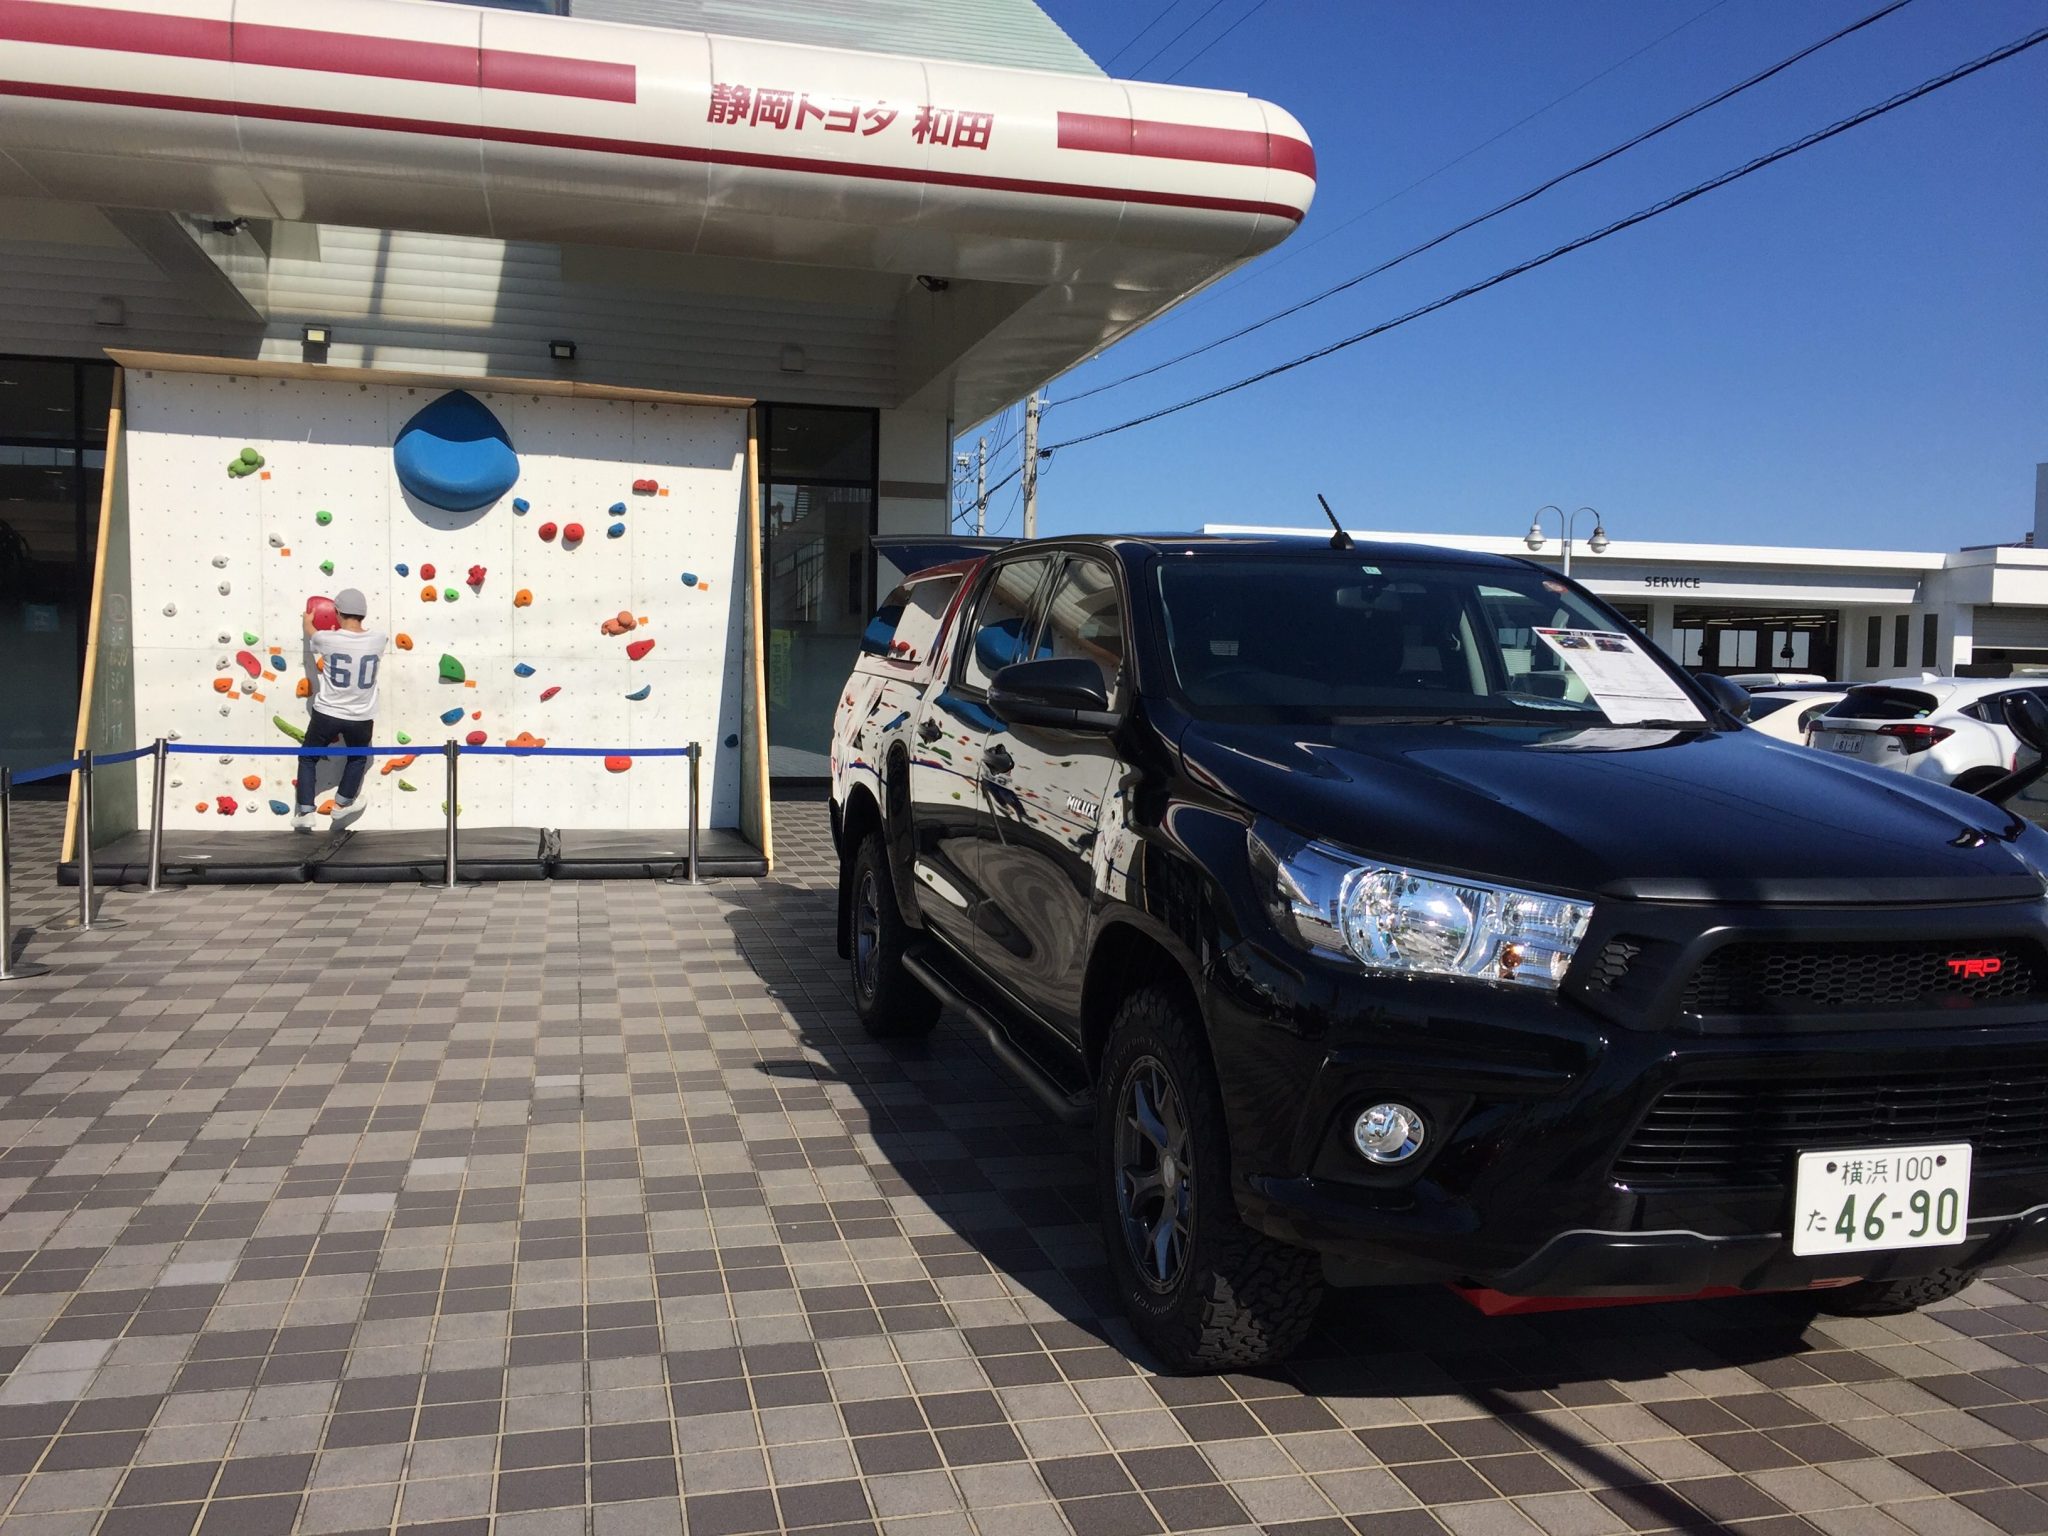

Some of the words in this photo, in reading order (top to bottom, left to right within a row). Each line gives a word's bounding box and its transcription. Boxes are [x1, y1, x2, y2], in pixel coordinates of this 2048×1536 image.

[707, 82, 898, 137] 静岡トヨタ
[912, 104, 994, 151] 和田
[1645, 576, 1700, 589] SERVICE
[330, 653, 379, 689] 60
[1066, 796, 1098, 820] HILUX
[1947, 958, 2001, 978] TRD
[1842, 1158, 1888, 1185] 横浜
[1896, 1156, 1933, 1182] 100
[1806, 1209, 1828, 1232] た
[1834, 1187, 1959, 1243] 46-90
